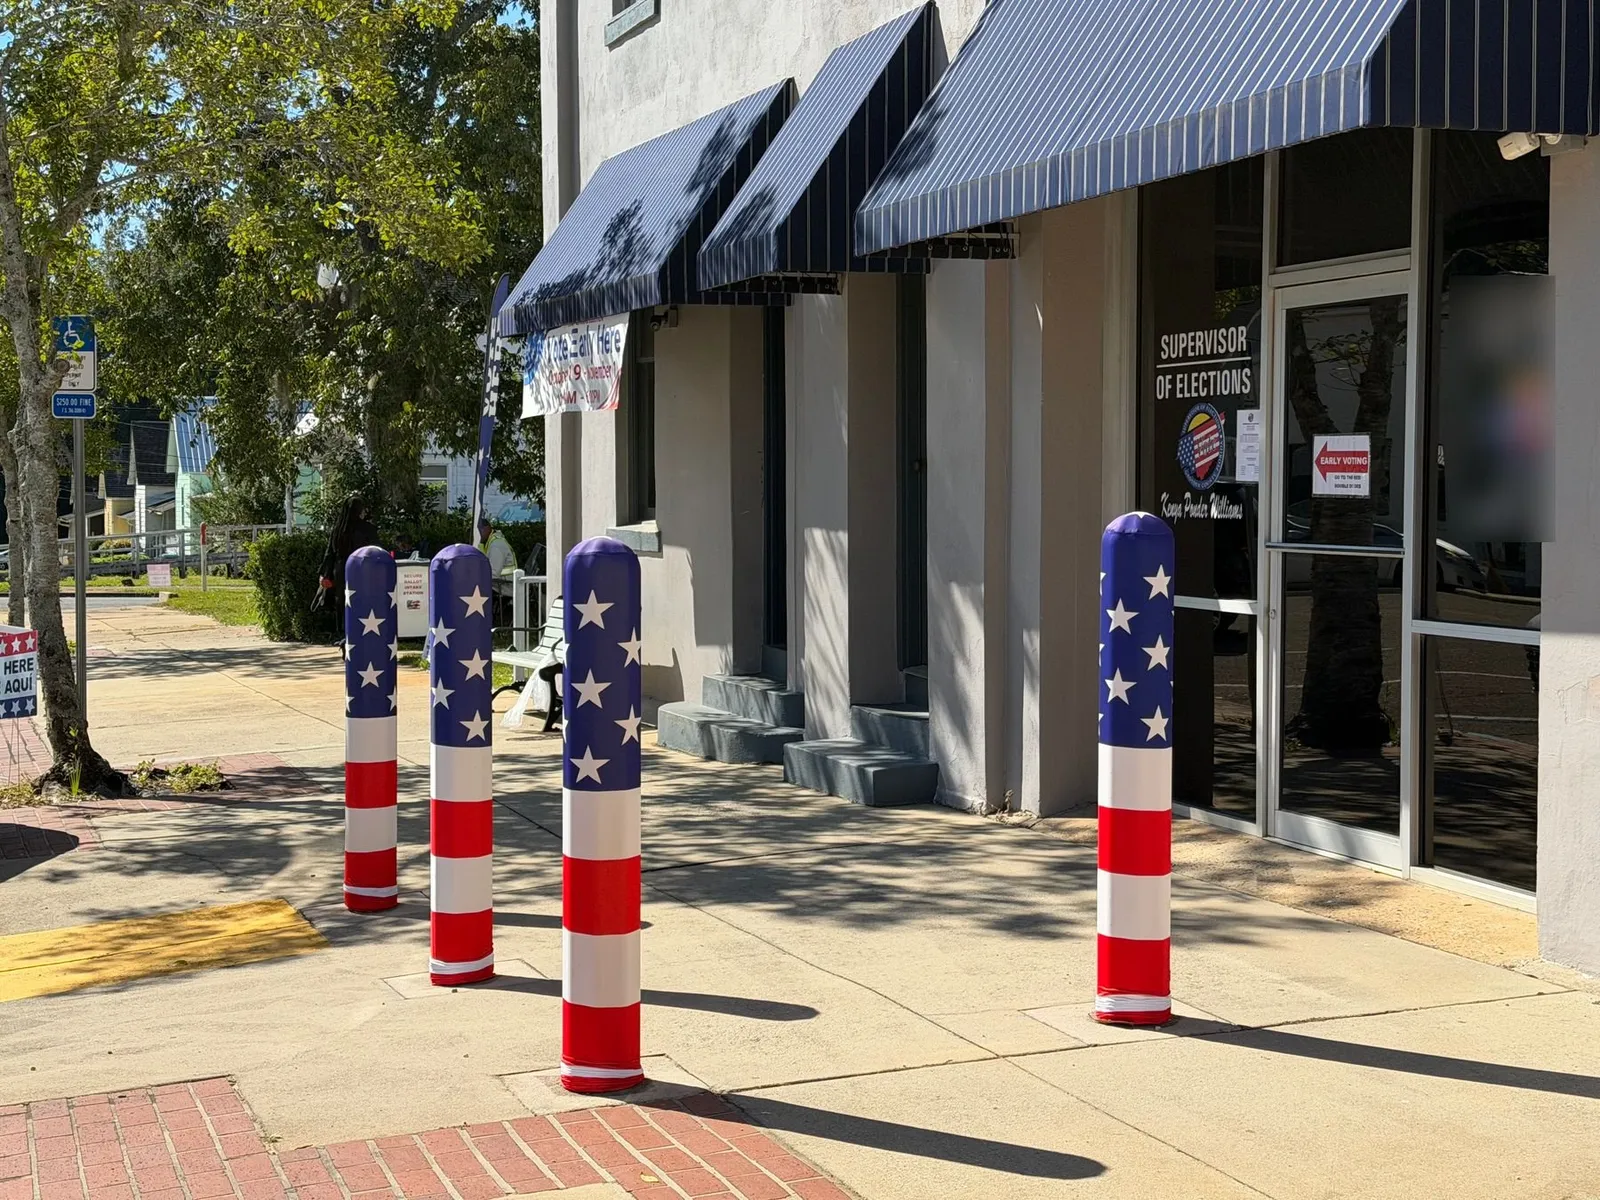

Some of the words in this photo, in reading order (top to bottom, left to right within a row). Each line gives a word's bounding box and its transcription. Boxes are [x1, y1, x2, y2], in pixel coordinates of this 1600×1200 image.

[597, 324, 621, 355] Here
[1160, 325, 1247, 359] SUPERVISOR
[1156, 374, 1173, 400] OF
[1176, 368, 1251, 398] ELECTIONS
[56, 397, 78, 406] $250.00
[79, 398, 92, 406] FINE
[1320, 456, 1341, 465] EARLY
[1343, 456, 1368, 465] VOTING
[1209, 492, 1243, 520] Williams
[4, 657, 34, 675] HERE
[4, 673, 33, 694] AQUÍ
